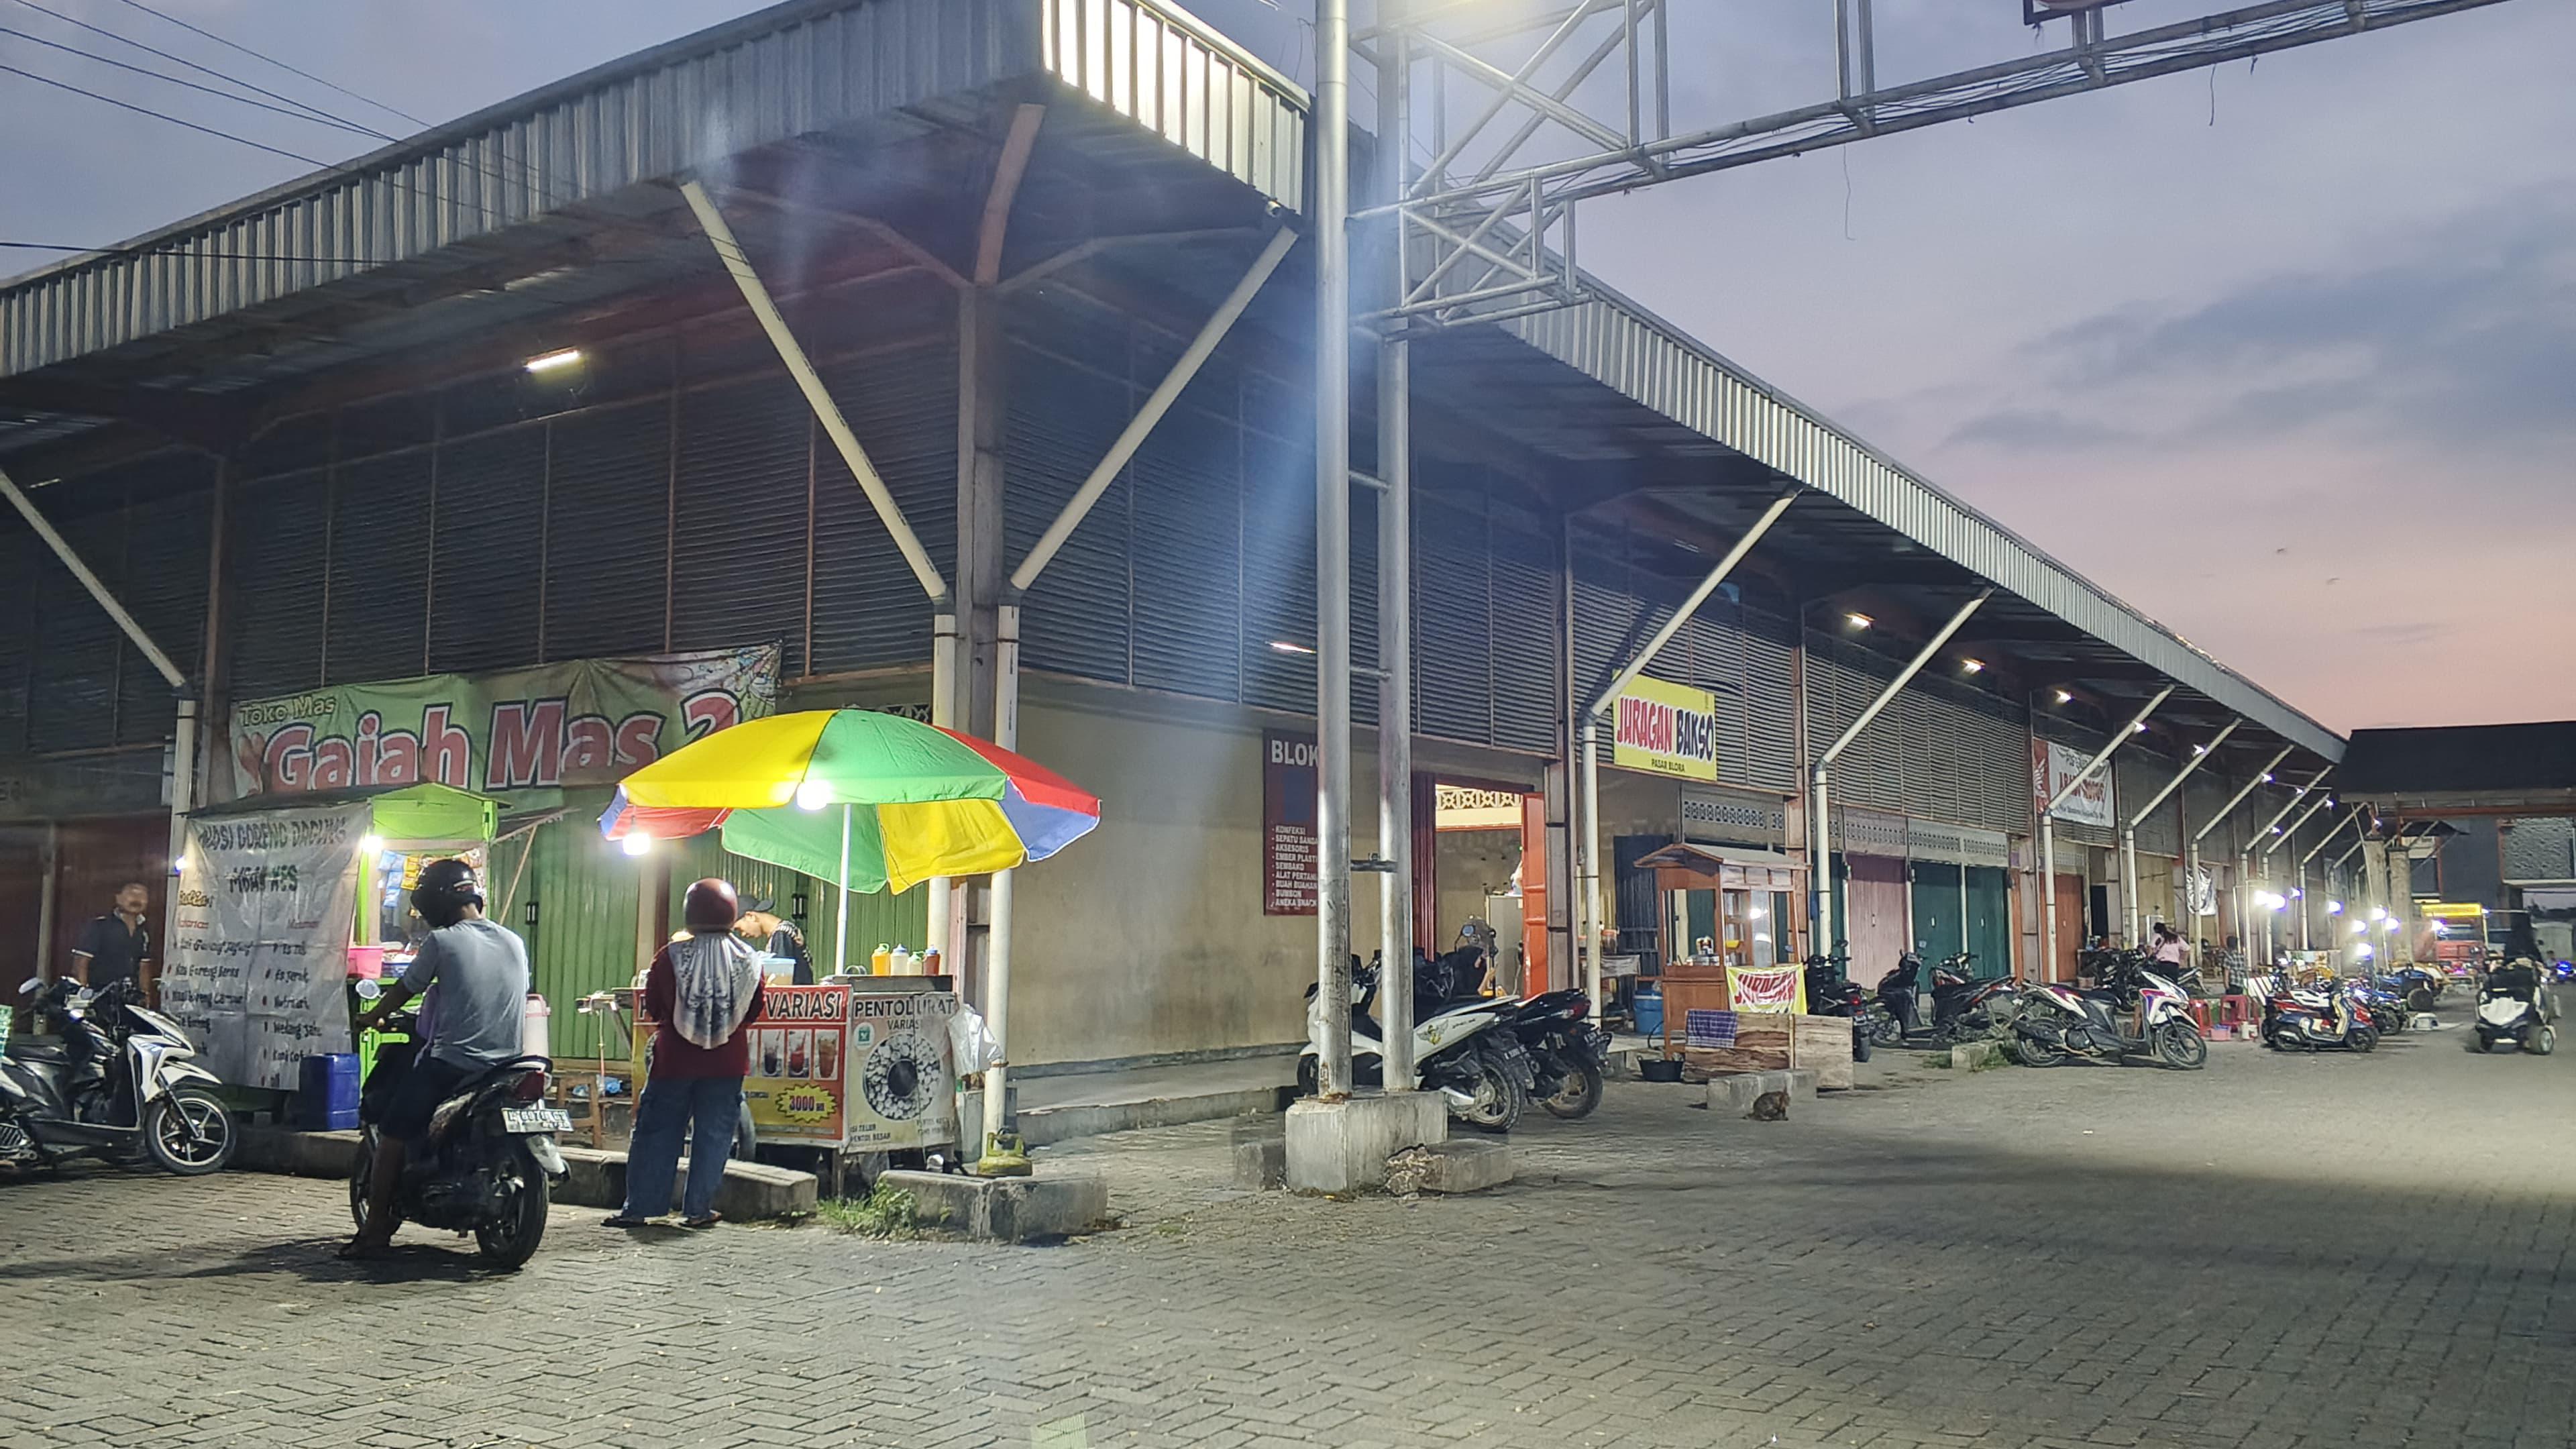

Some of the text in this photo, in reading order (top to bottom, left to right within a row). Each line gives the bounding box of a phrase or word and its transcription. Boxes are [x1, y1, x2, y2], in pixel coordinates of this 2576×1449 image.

[239, 695, 336, 727] Toko Mas
[1617, 696, 1715, 762] JURAGAN BAKSO
[483, 695, 667, 792] Mas
[1271, 739, 1318, 767] BLOK
[199, 825, 234, 851] NASI
[236, 822, 288, 851] GORENG
[1275, 824, 1306, 835] KONFEKSI
[1275, 834, 1318, 845] SEPATU SANDA
[1275, 843, 1309, 853] AKSESORIS
[1275, 853, 1318, 864] EMBER PLASTI
[1275, 862, 1305, 871] SEMBAKO
[1275, 871, 1318, 881] ALAT PERTANI
[1275, 880, 1293, 889] BUAH
[1275, 898, 1297, 907] ANEKA
[765, 990, 843, 1019] VARIASI
[855, 999, 914, 1017] PENTOL
[789, 1095, 815, 1112] 3000
